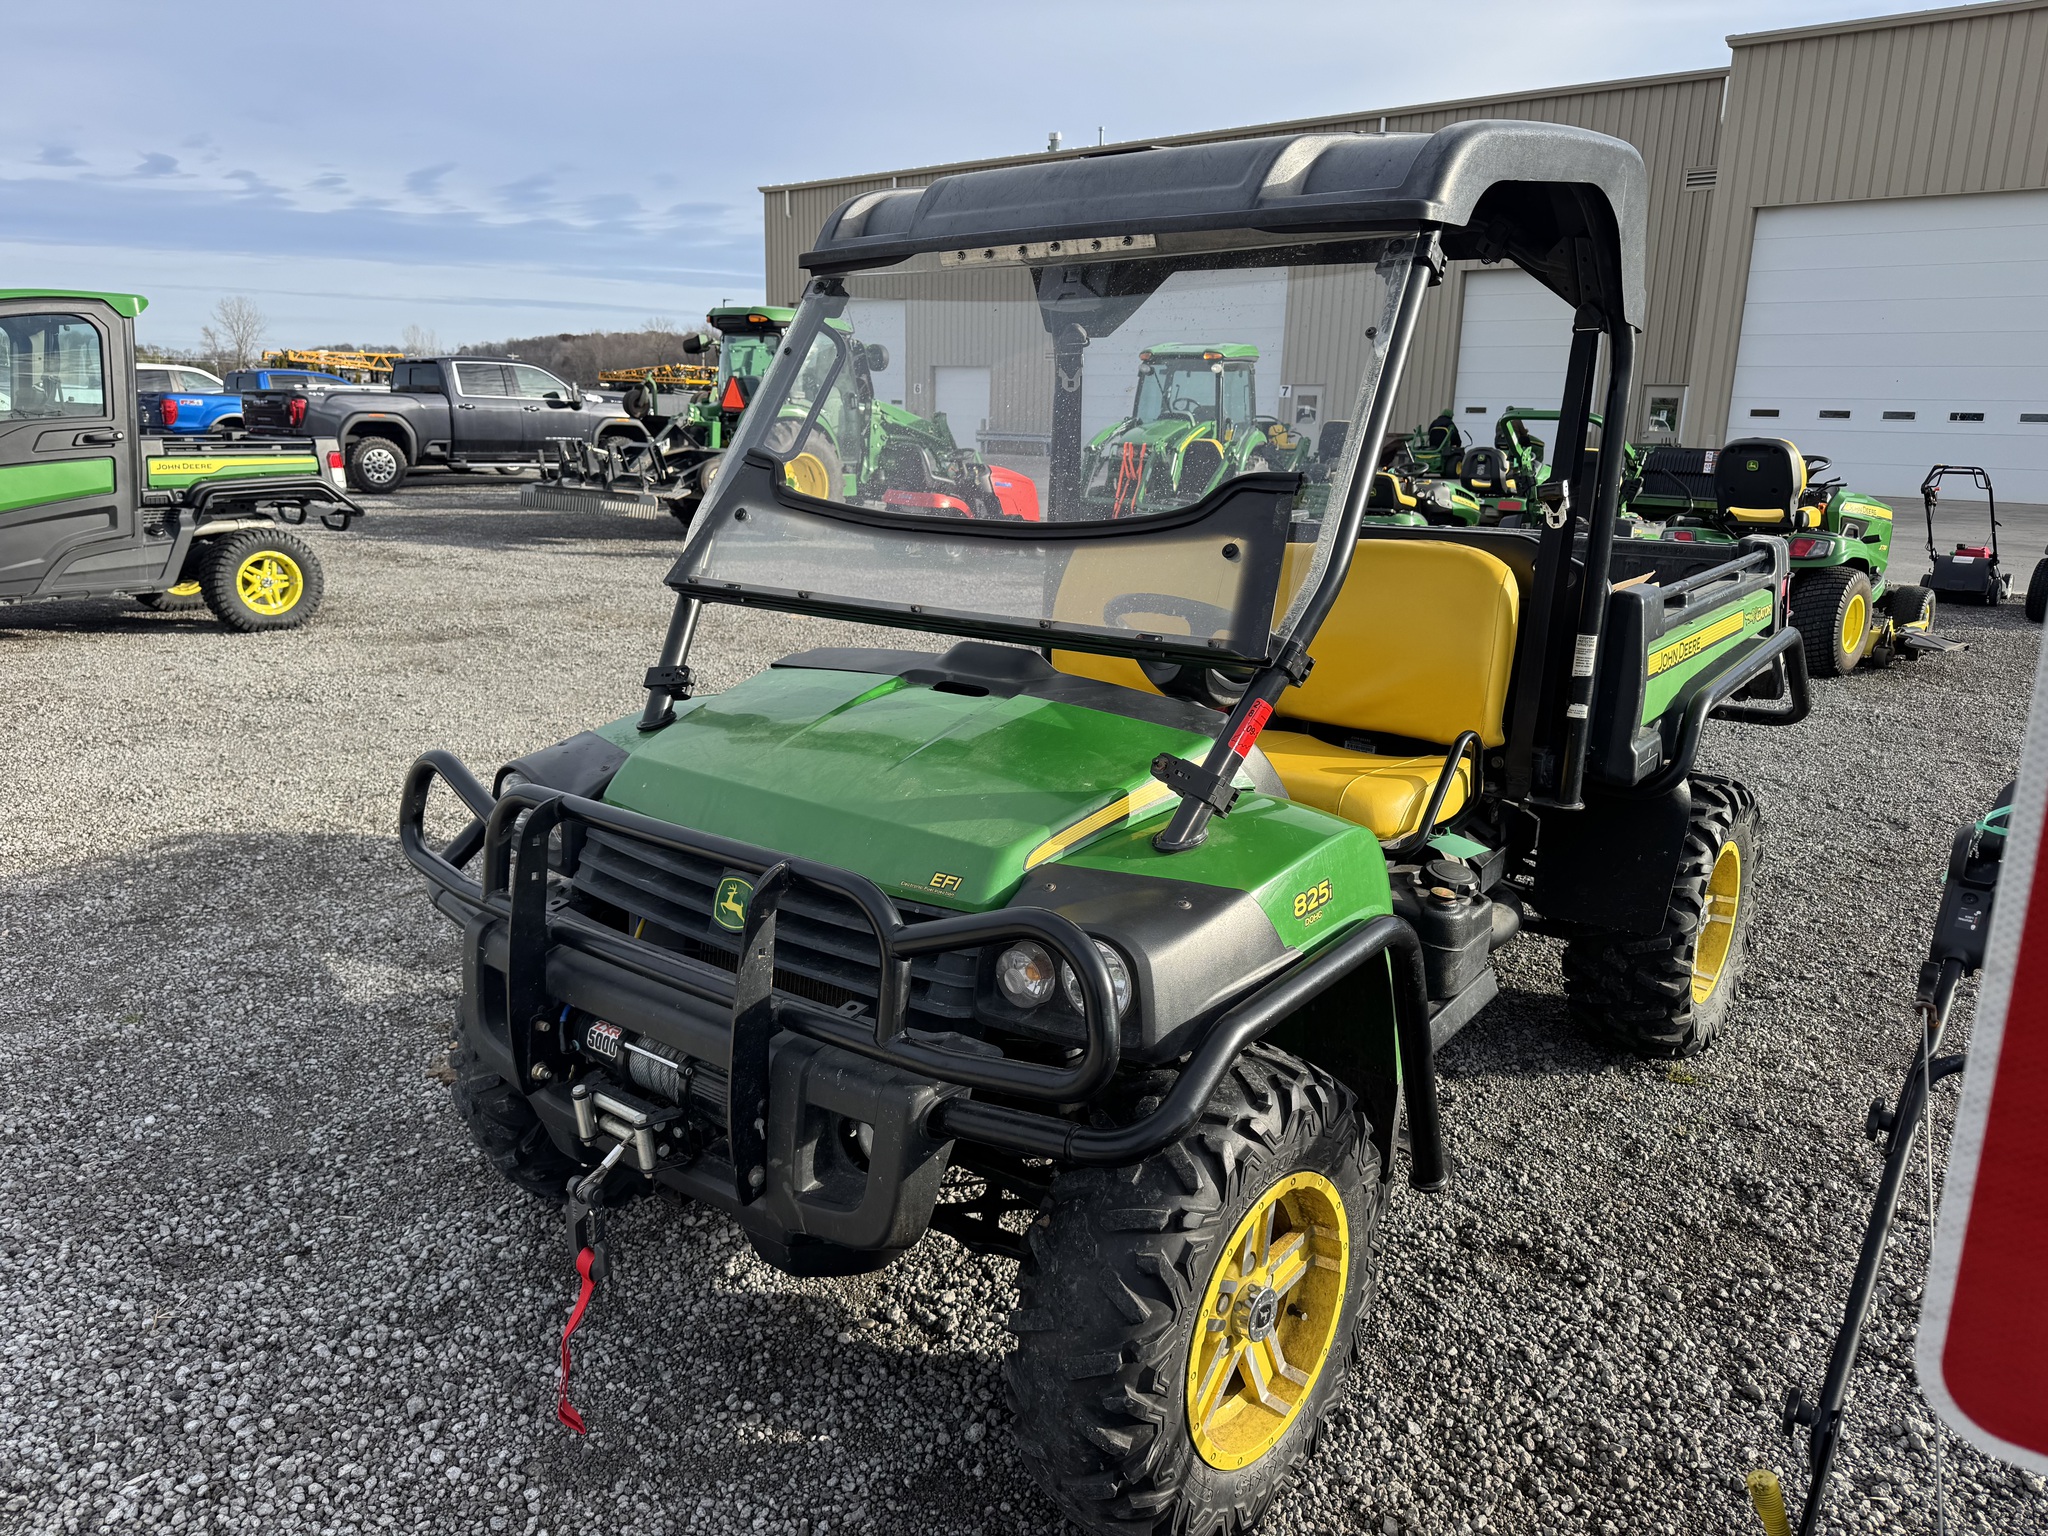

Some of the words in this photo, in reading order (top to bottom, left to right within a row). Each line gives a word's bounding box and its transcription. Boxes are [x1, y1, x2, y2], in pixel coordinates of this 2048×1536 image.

[1282, 386, 1289, 396] 7
[1658, 647, 1680, 670] JOHN
[1679, 637, 1701, 659] DEERE
[1253, 700, 1260, 709] 2
[900, 880, 923, 890] Electronic
[928, 871, 964, 892] EFI
[1293, 878, 1333, 920] 825i
[1304, 910, 1323, 927] DOHC
[593, 1020, 622, 1038] ZXR
[587, 1029, 618, 1057] 5000
